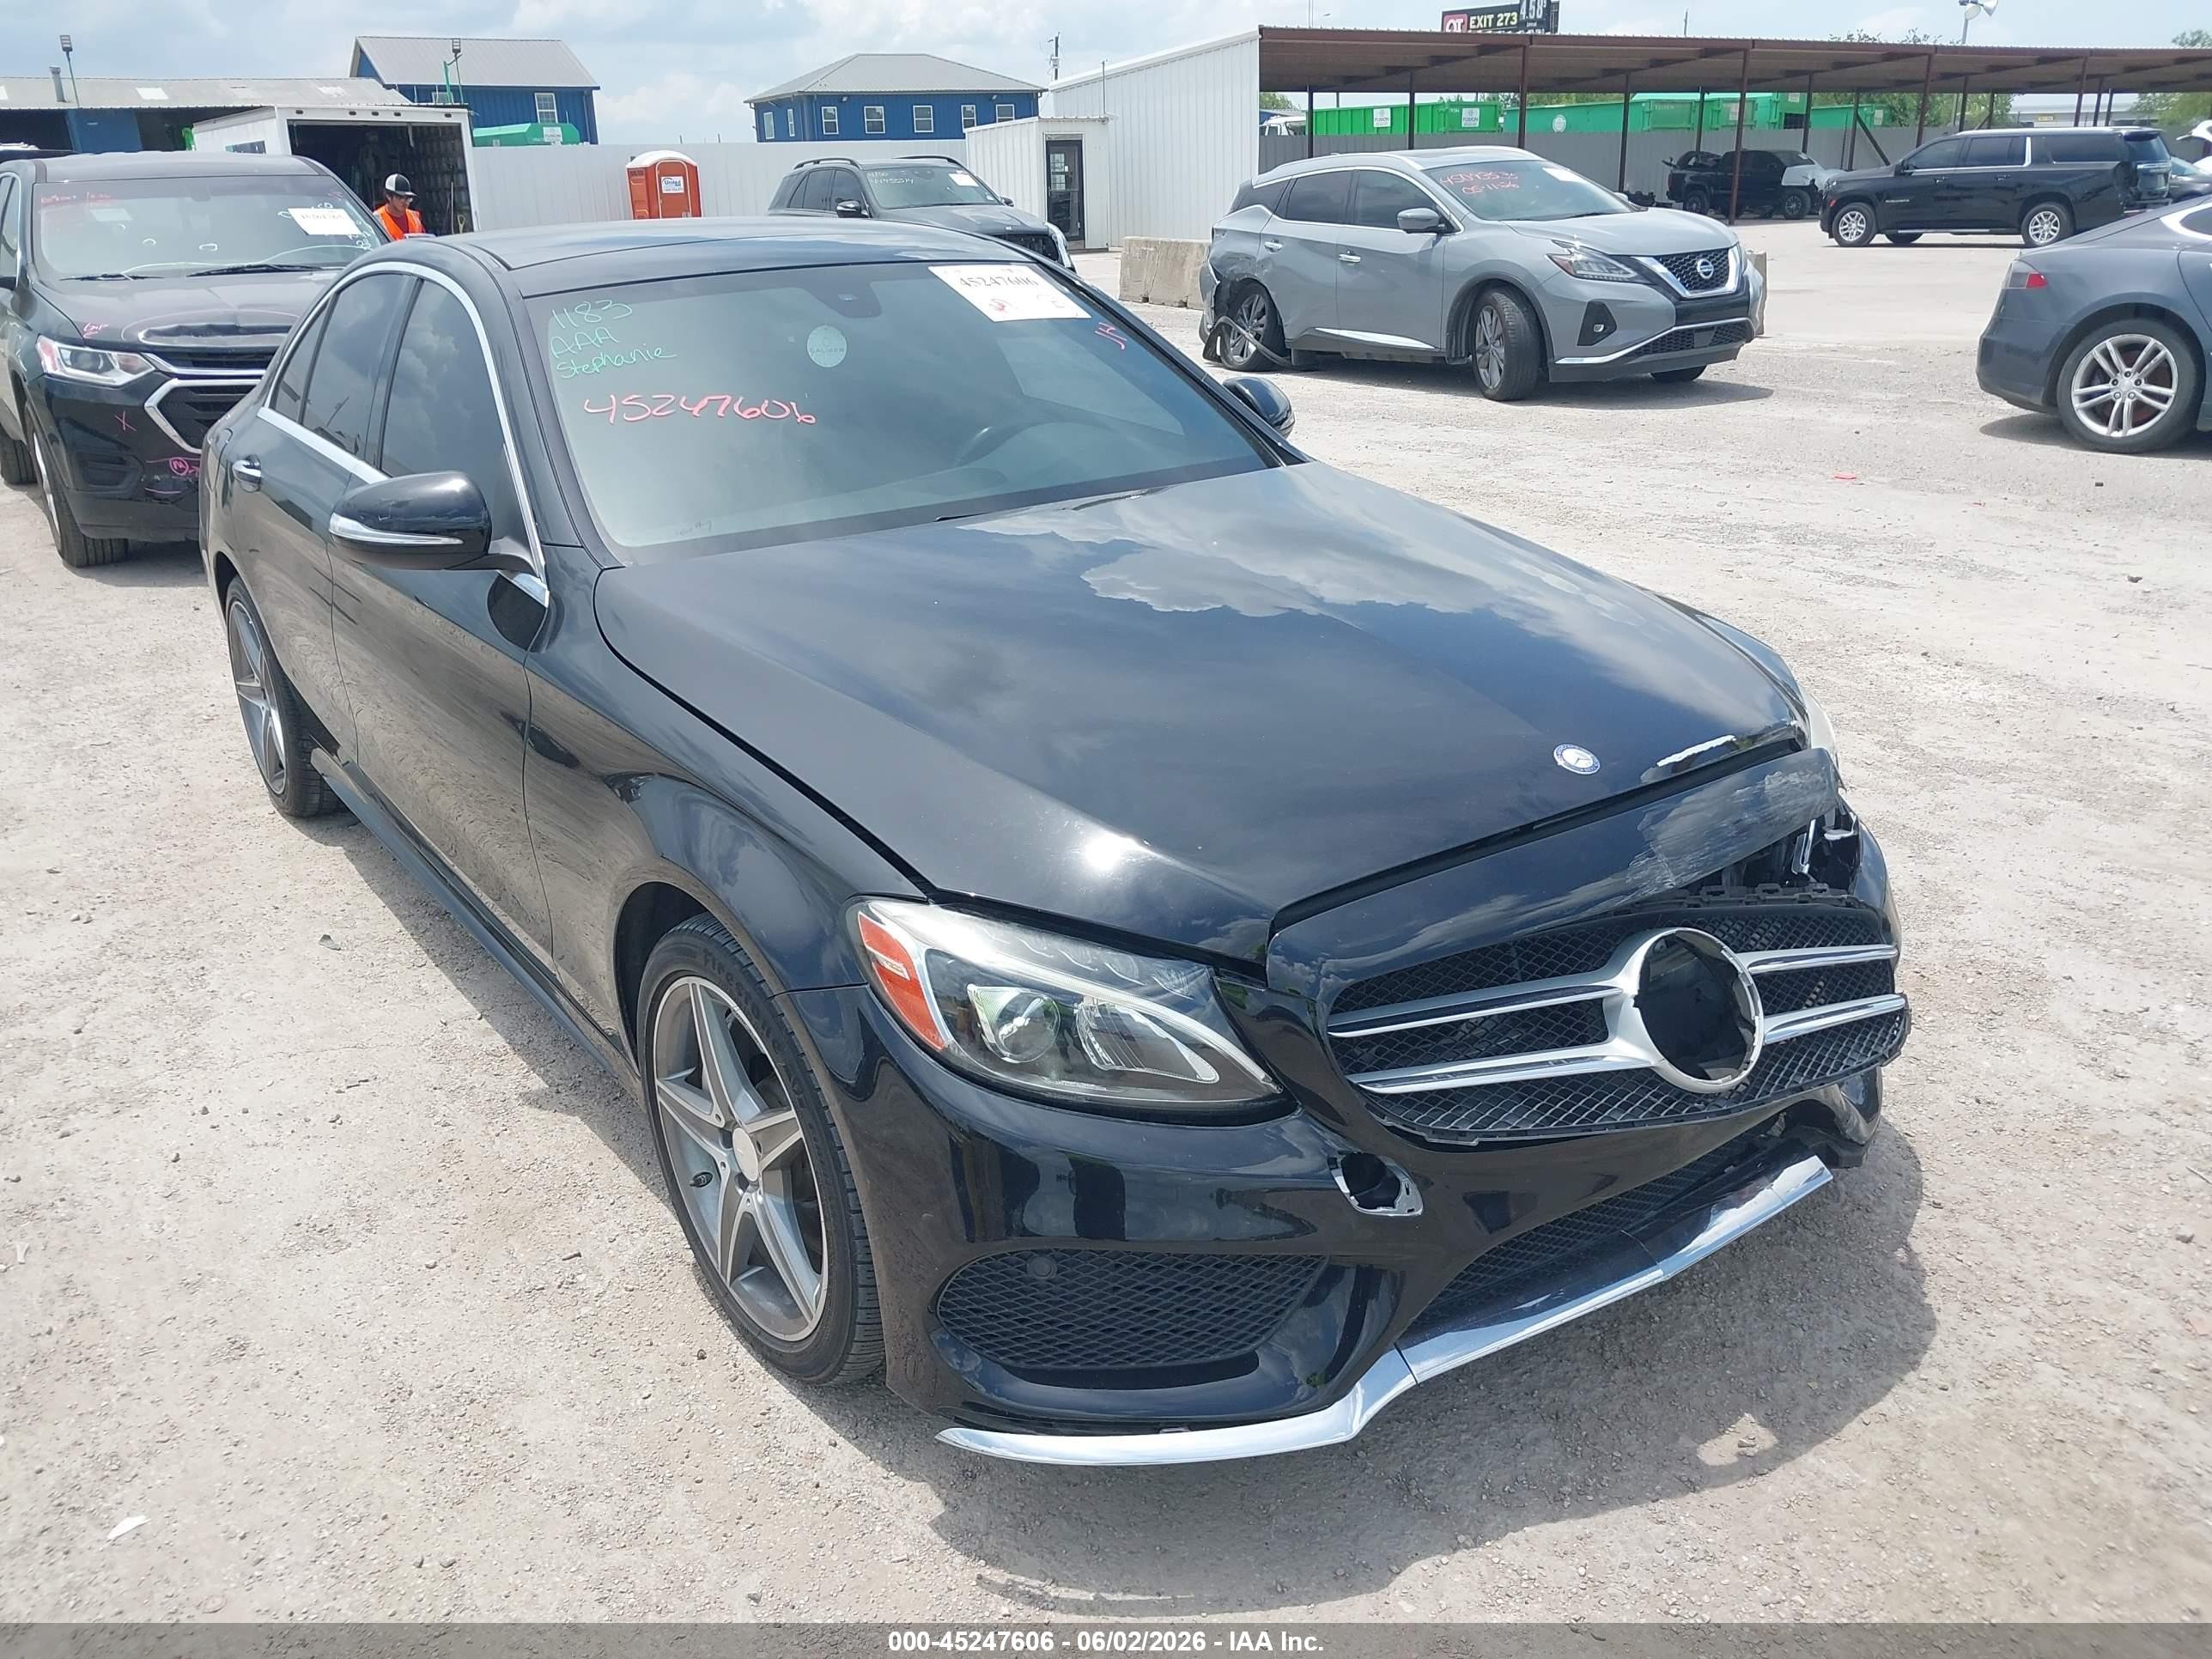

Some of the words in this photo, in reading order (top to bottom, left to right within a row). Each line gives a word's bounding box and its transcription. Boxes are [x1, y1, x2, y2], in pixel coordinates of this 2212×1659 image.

[1469, 15, 1494, 29] EXIT
[1497, 11, 1518, 27] 273
[959, 276, 1040, 289] 45247606
[551, 300, 633, 329] 1183
[550, 326, 620, 358] AAA
[556, 343, 678, 379] Stephanie
[584, 393, 817, 425] 45247606
